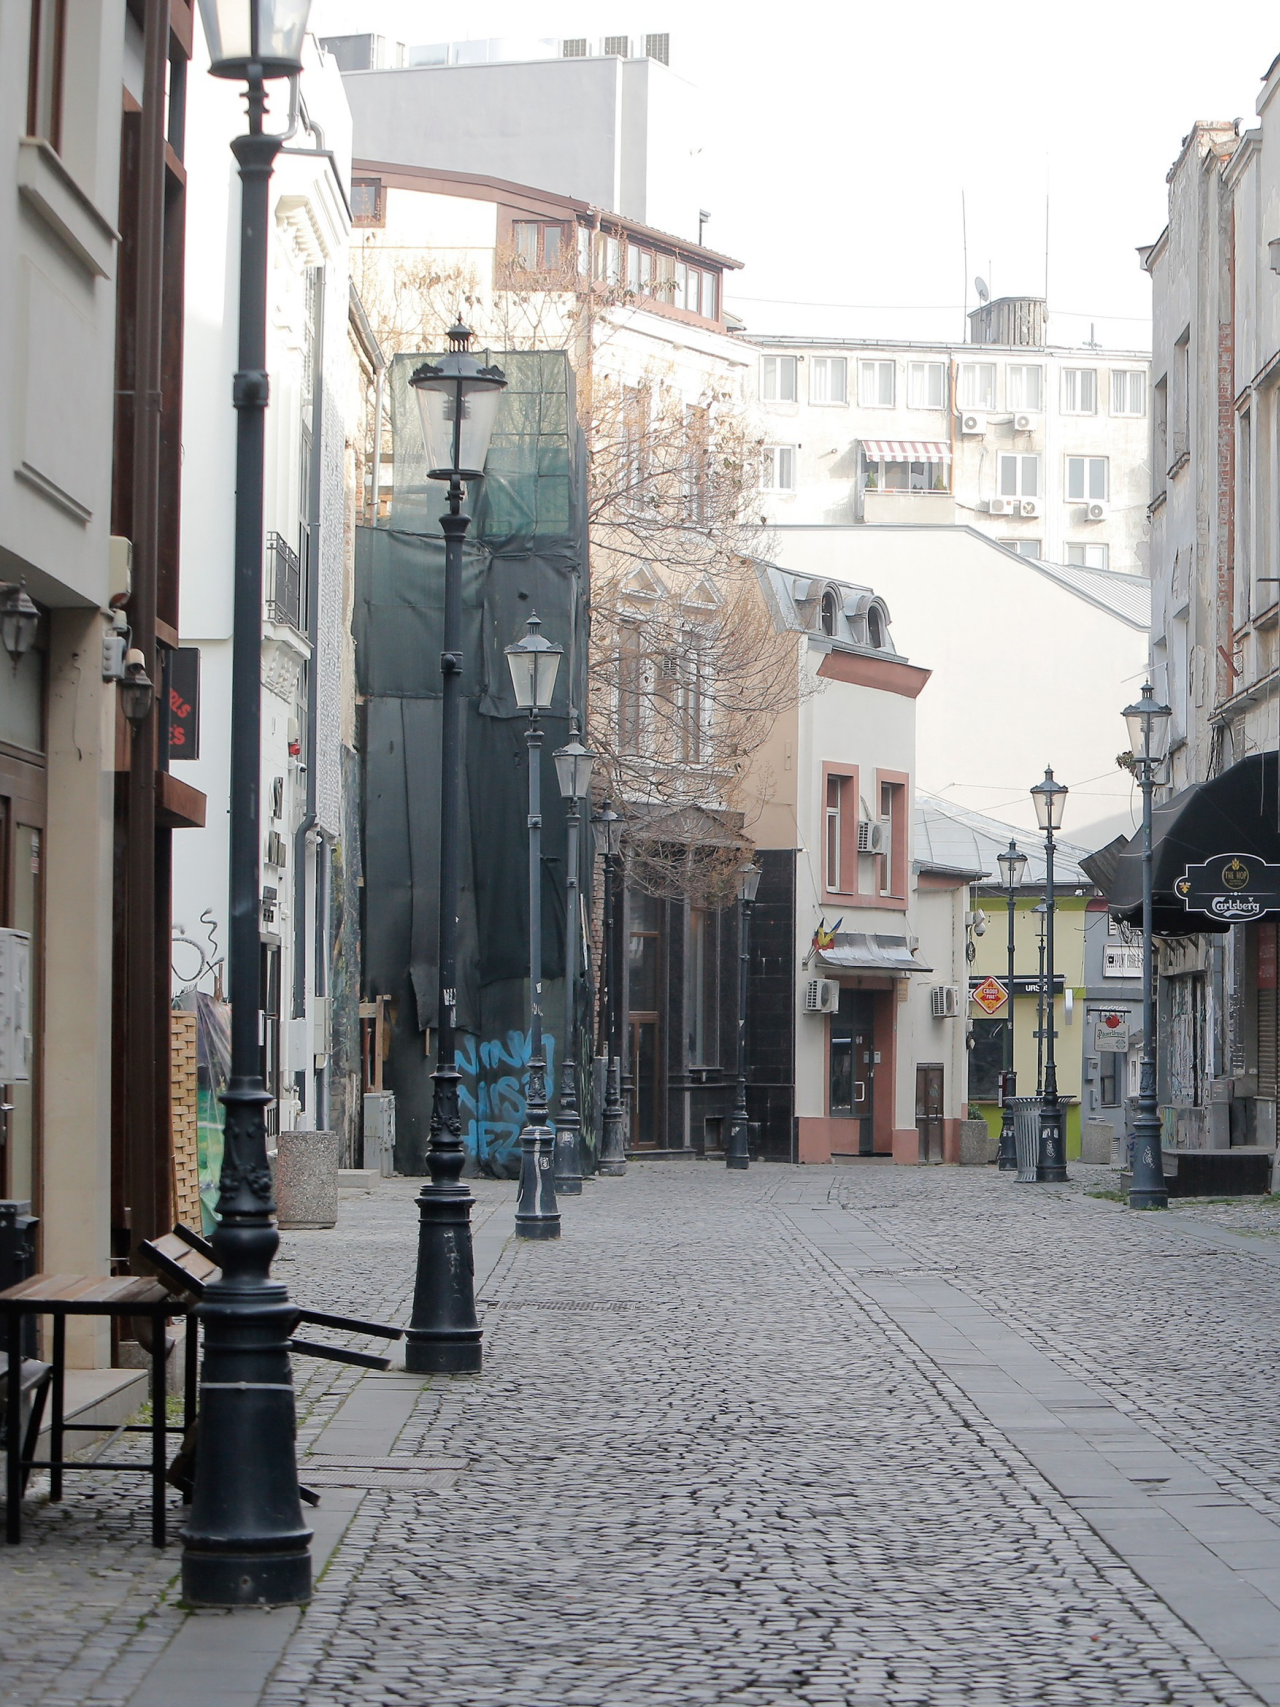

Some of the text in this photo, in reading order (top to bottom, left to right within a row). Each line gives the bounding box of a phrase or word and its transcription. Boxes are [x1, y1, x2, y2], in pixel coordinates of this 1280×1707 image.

[1225, 871, 1247, 880] THE HOP
[1211, 896, 1260, 914] Carlsberg
